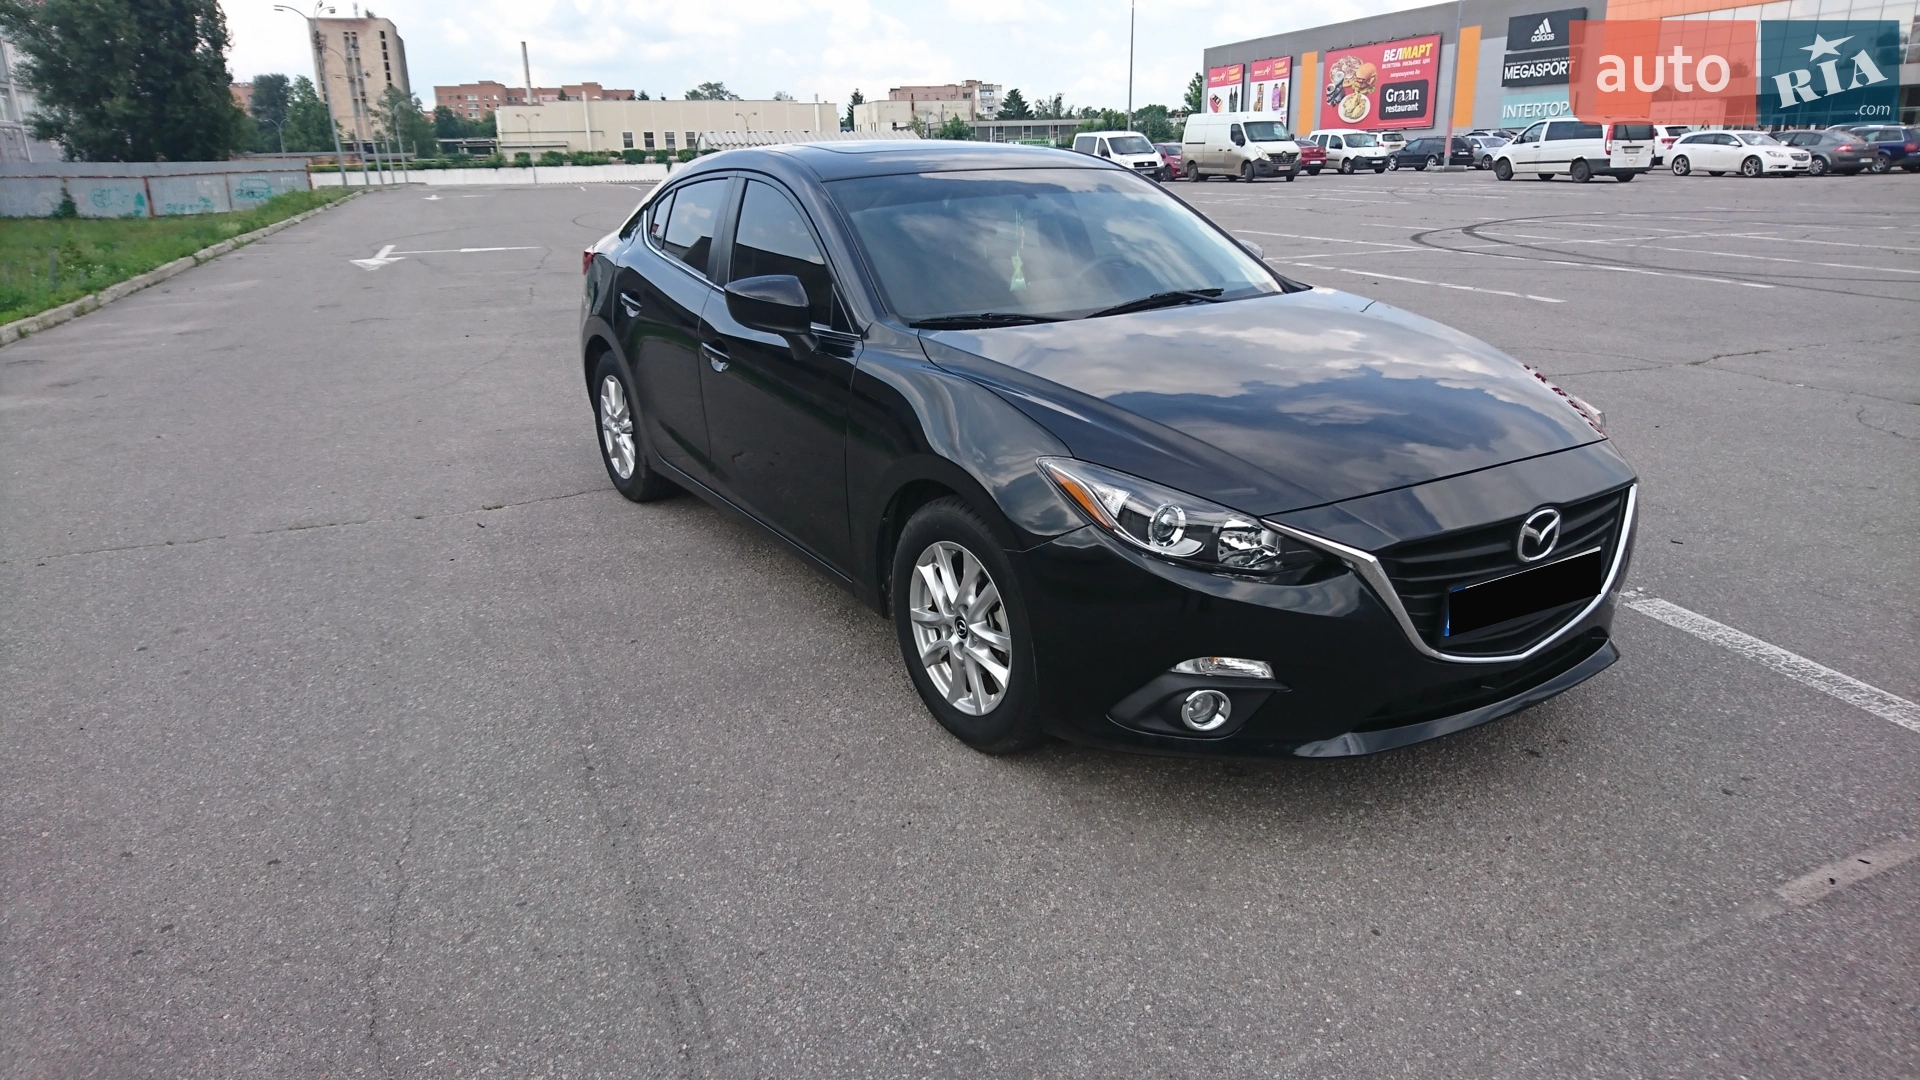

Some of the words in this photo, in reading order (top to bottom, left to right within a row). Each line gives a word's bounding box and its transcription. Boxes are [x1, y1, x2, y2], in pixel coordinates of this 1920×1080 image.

[1531, 33, 1555, 43] adidas
[1383, 43, 1433, 62] ВЕЛМАРТ
[1504, 60, 1576, 79] MEGASPORT
[1385, 103, 1419, 113] restaurant
[1502, 101, 1569, 118] INTERTOP
